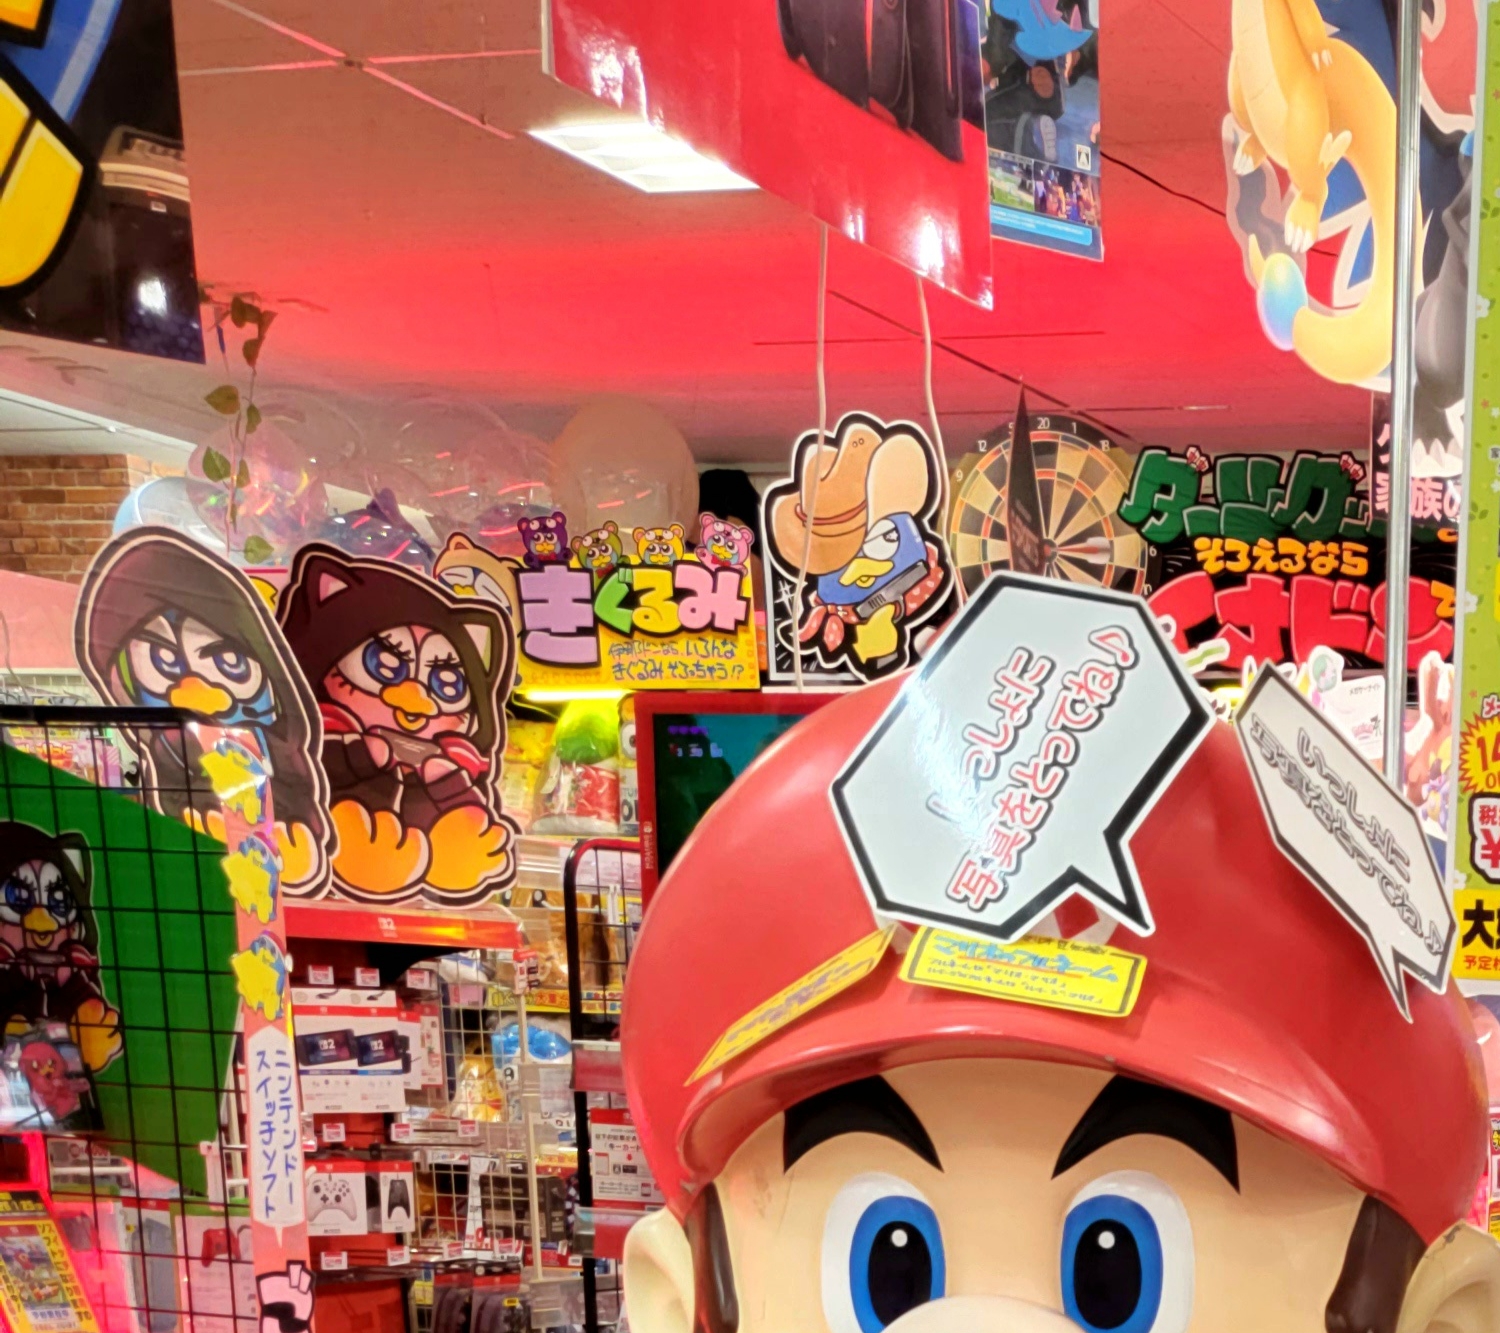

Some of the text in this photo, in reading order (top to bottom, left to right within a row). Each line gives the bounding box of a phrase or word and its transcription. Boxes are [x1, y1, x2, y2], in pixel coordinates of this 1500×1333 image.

[1036, 417, 1051, 430] 20
[519, 565, 747, 664] きぐるみ
[1194, 537, 1369, 576] そろえるなら
[1299, 727, 1411, 885] いっしょに
[256, 1050, 278, 1220] スイッチソフト
[275, 1049, 298, 1205] ニンテンドー
